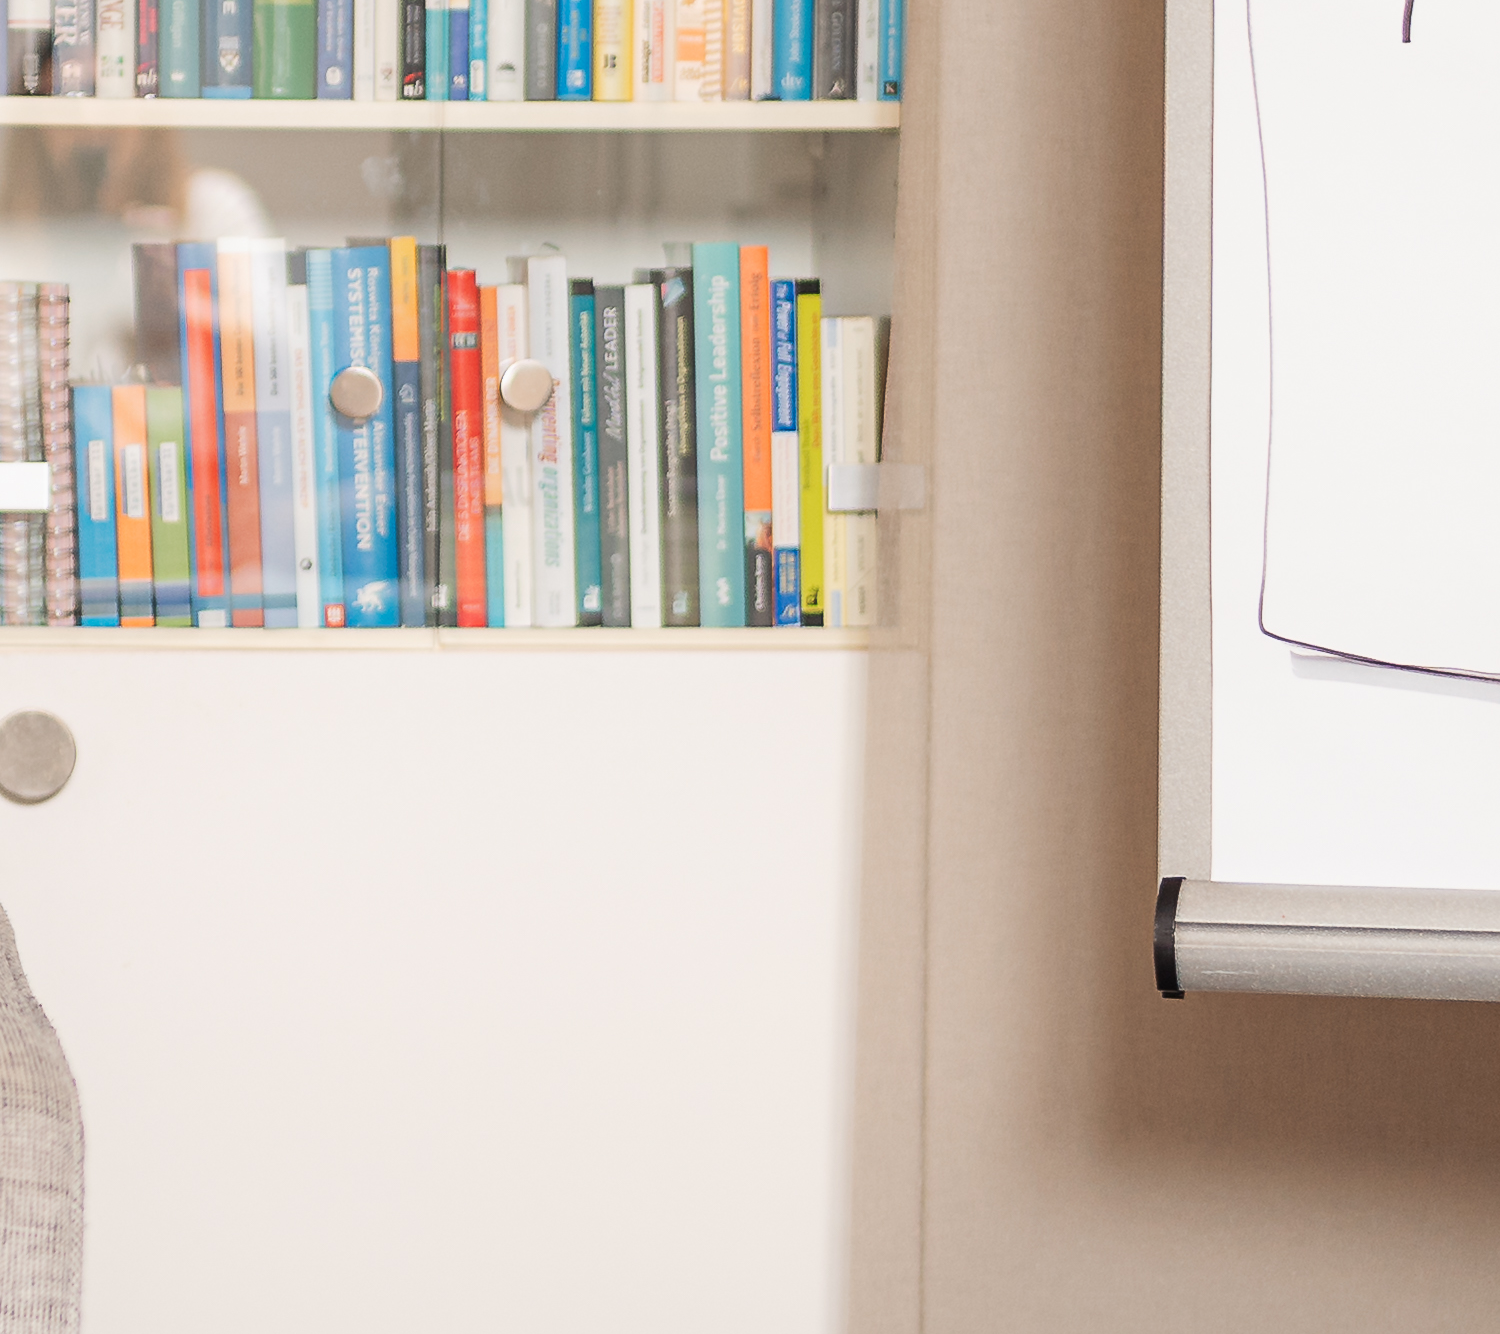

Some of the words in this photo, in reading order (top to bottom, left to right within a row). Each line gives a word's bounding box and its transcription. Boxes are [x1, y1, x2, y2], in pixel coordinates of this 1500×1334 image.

[169, 0, 187, 48] Gilligan
[367, 267, 380, 321] Roswita
[748, 272, 763, 311] Erfolg
[775, 300, 792, 332] Power
[603, 306, 619, 371] LEADER
[707, 275, 730, 381] Leadership
[776, 340, 792, 362] Full
[749, 337, 763, 432] Selbstreflexion
[775, 362, 793, 427] Engagement
[709, 384, 730, 462] Positive
[353, 417, 372, 550] TERVENTION
[372, 420, 386, 492] Alexander
[374, 494, 388, 535] Exner
[541, 467, 564, 568] organizations
